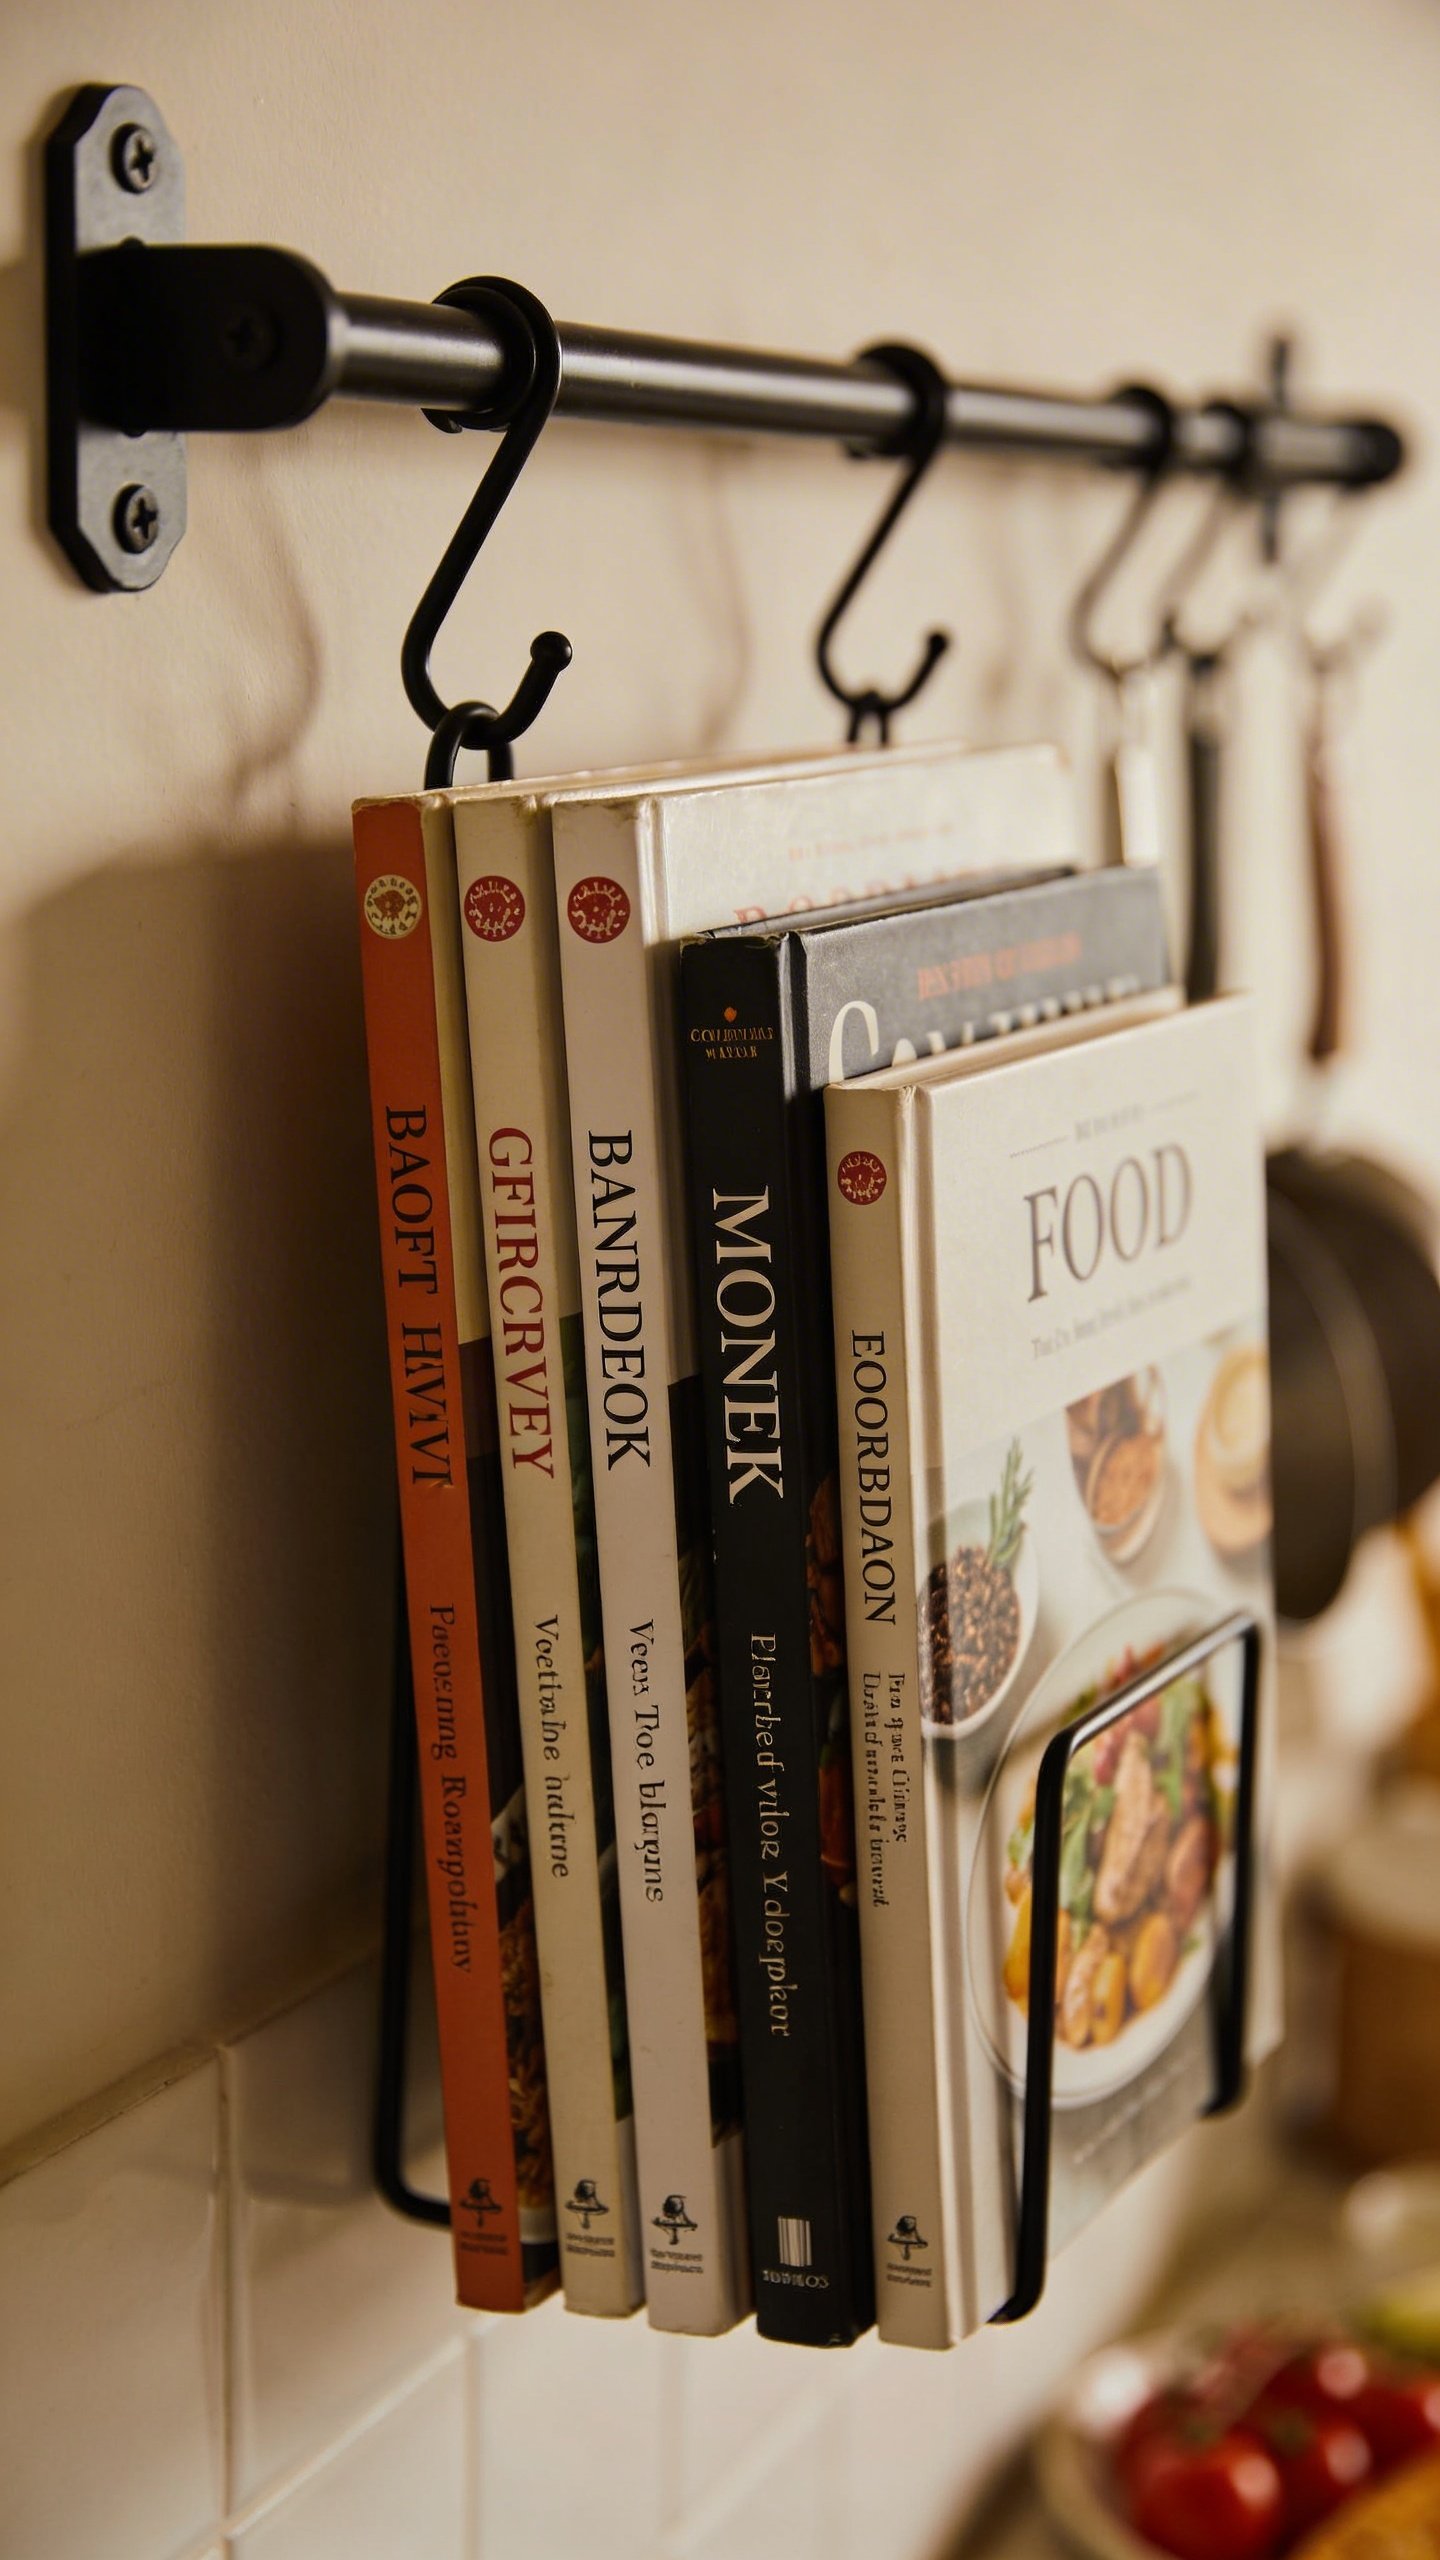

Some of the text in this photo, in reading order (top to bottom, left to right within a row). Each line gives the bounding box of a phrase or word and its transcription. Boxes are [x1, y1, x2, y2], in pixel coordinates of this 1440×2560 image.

[385, 1105, 439, 1295] BAOFT
[489, 1127, 554, 1479] GFIRCRVEY
[588, 1129, 651, 1472] BANRDEOK
[712, 1184, 785, 1505] MONEK
[1023, 1142, 1193, 1303] FOOD
[851, 1329, 896, 1626] EOORBDAON
